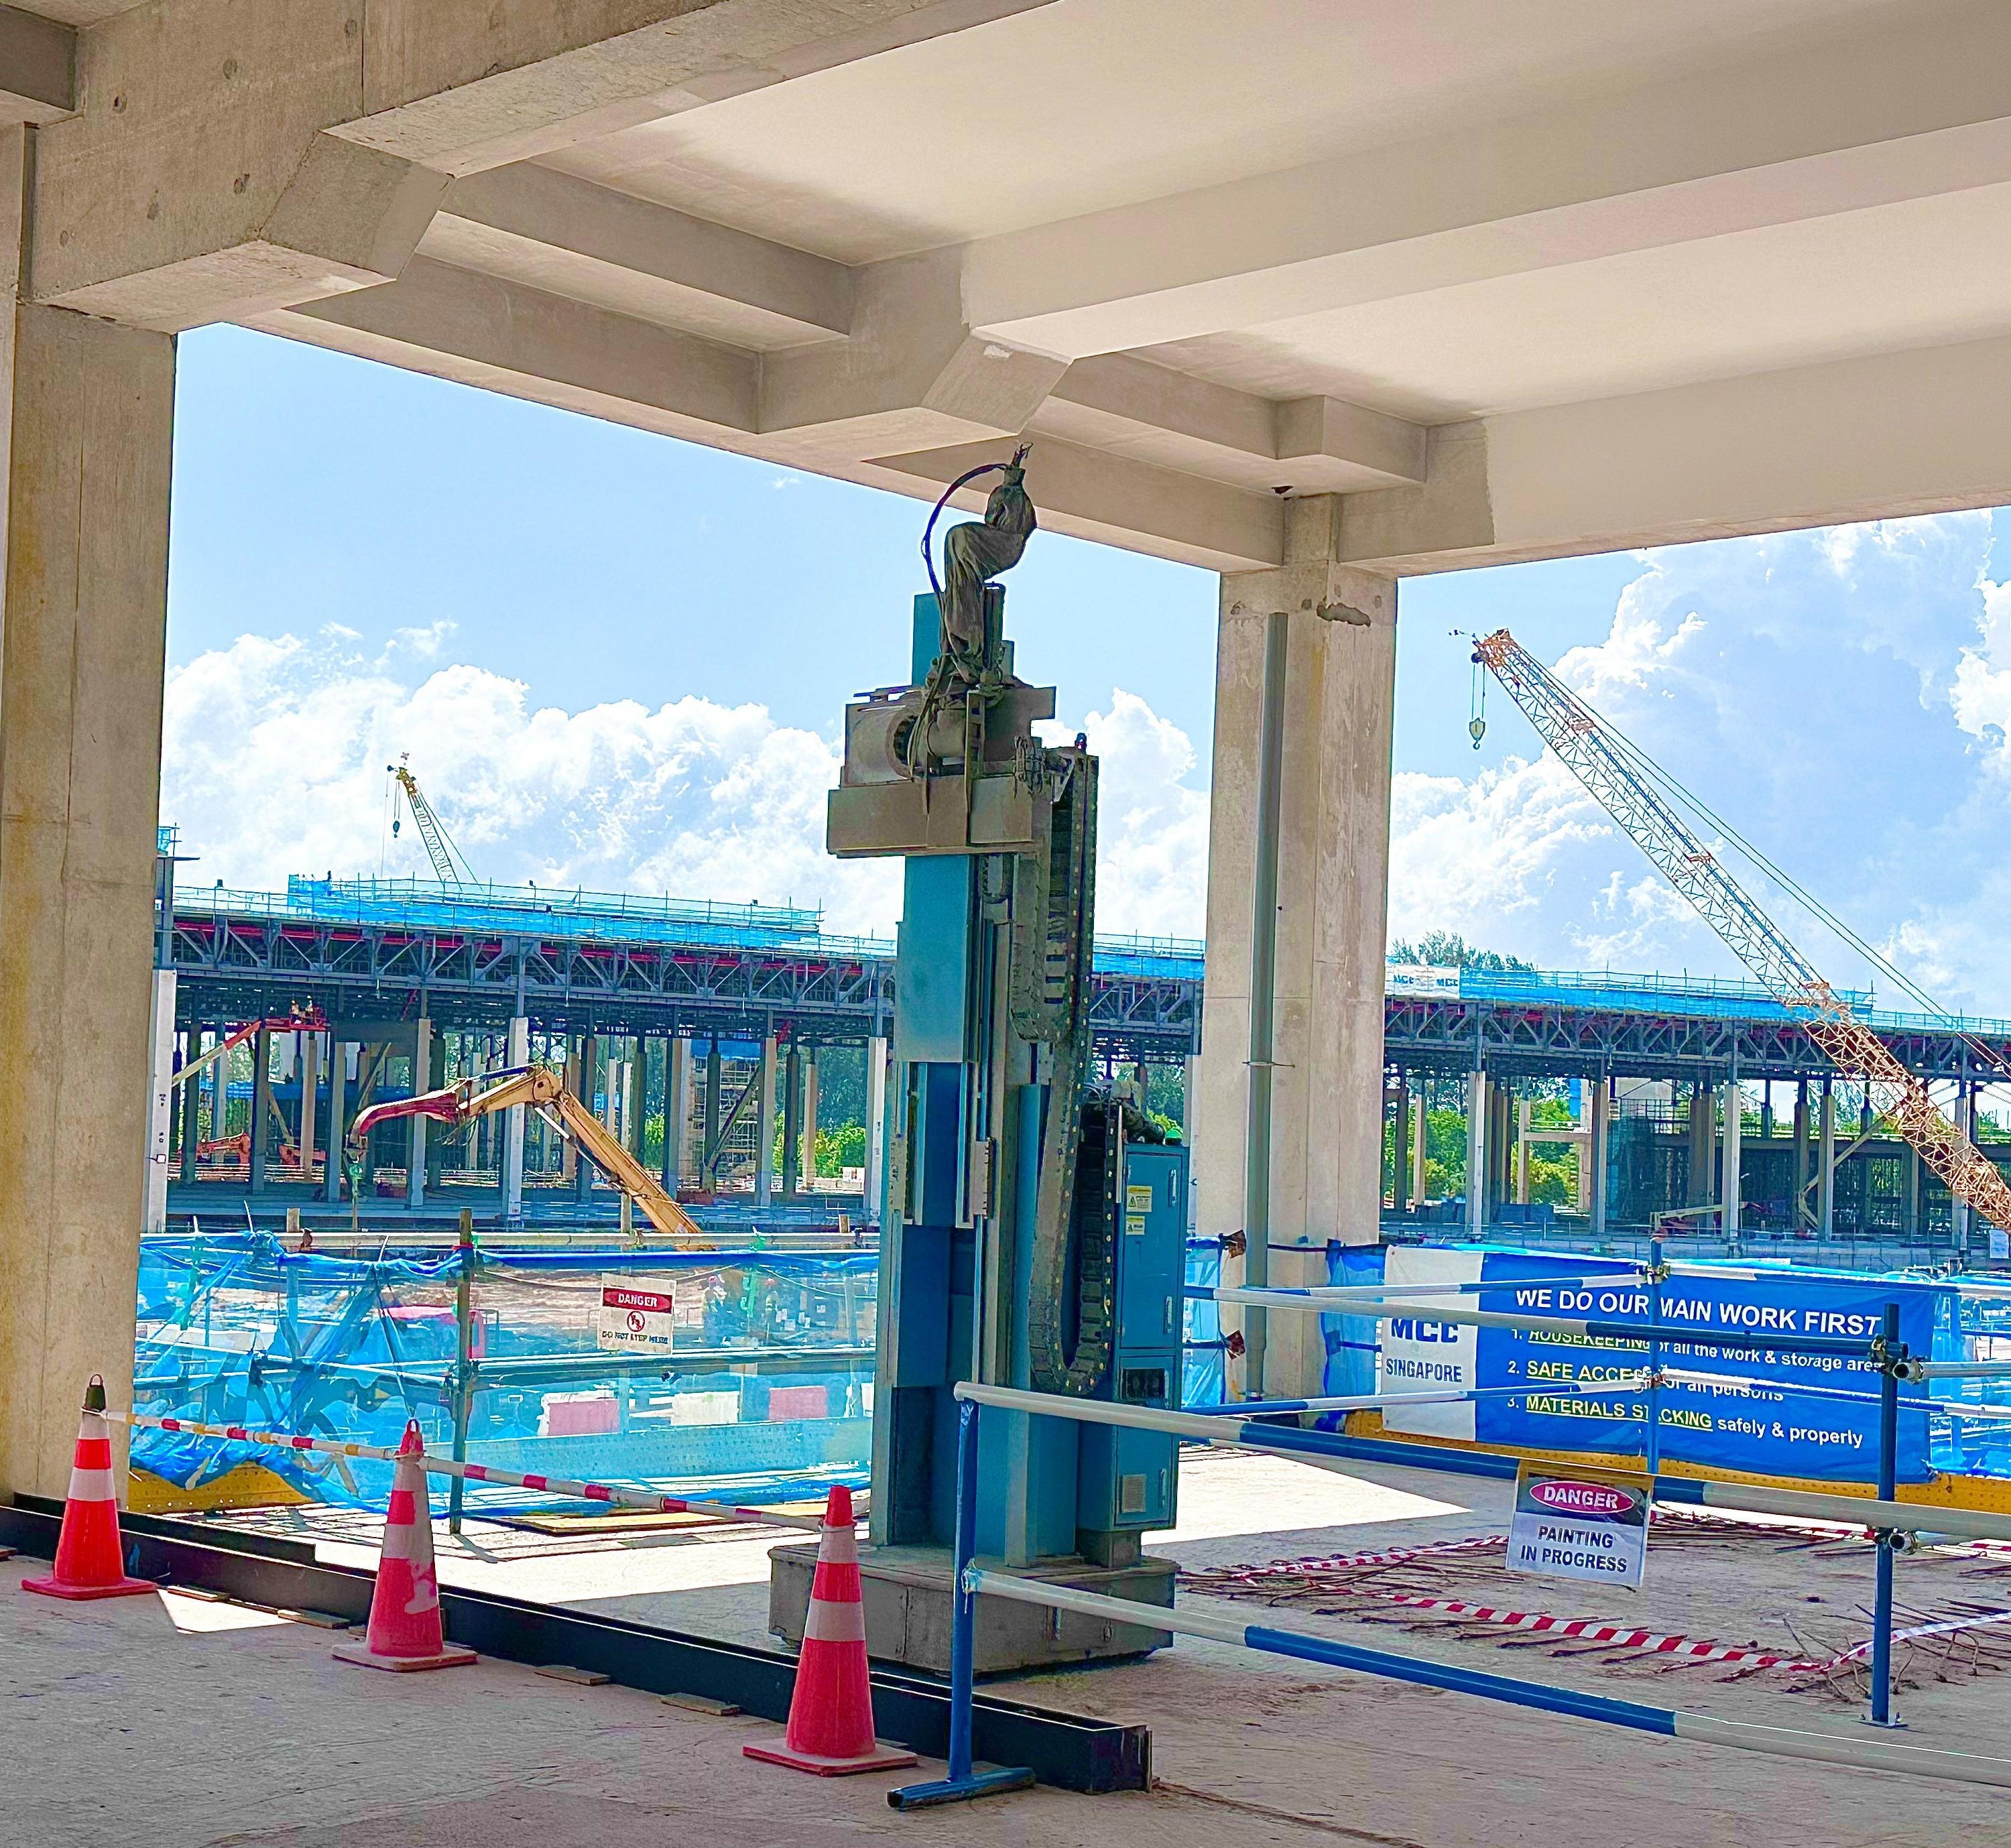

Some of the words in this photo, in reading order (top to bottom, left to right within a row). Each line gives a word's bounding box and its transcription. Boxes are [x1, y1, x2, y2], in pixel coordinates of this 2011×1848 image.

[618, 1293, 658, 1307] DANGER
[1516, 1289, 1552, 1308] WE
[1559, 1290, 1593, 1310] DO
[1599, 1292, 1649, 1315] OUR
[1719, 1303, 1797, 1330] WORK
[1805, 1311, 1882, 1336] FIRST
[1391, 1318, 1459, 1343] MCC
[1508, 1360, 1520, 1374] 2.
[1527, 1360, 1573, 1379] SAFE
[1673, 1343, 1690, 1355] all
[1695, 1344, 1718, 1358] the
[1722, 1347, 1760, 1362] work
[1765, 1350, 1776, 1364] &
[1781, 1353, 1842, 1372] storage
[1386, 1358, 1462, 1383] SINGAPORE
[1526, 1395, 1626, 1418] MATERIALS
[1717, 1418, 1766, 1439] safely
[1772, 1421, 1784, 1438] &
[1789, 1426, 1863, 1449] properly
[1543, 1485, 1618, 1509] DANGER
[1538, 1526, 1613, 1548] PAINTING
[1520, 1545, 1537, 1561] IN
[1542, 1548, 1628, 1573] PROGRESS
